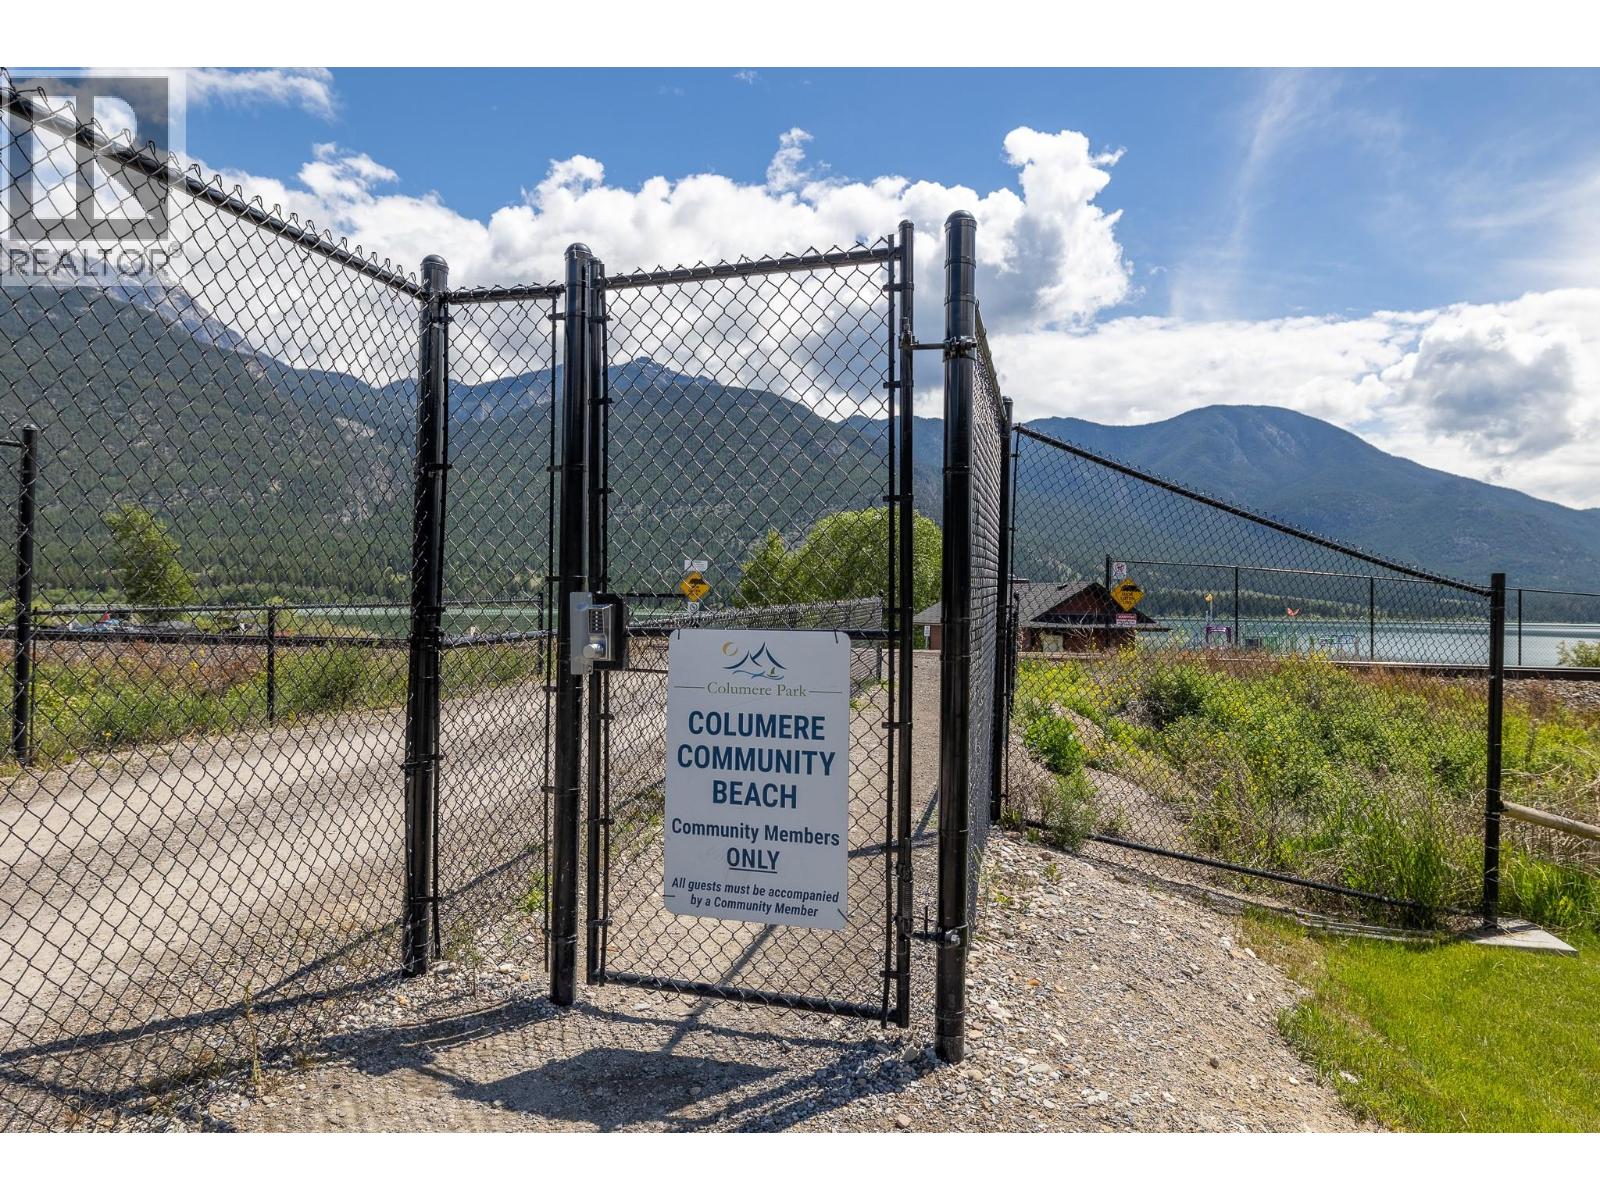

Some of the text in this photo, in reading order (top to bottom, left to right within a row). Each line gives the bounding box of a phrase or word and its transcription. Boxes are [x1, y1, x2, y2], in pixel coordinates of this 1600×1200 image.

[707, 682, 807, 697] Columere Park
[688, 710, 826, 741] COLUMERE
[677, 743, 836, 776] COMMUNITY
[712, 779, 797, 809] BEACH
[671, 817, 840, 846] Community Members
[726, 847, 780, 870] ONLY
[671, 877, 840, 903] All guests must be accompanied
[690, 894, 819, 918] by a Community Member
